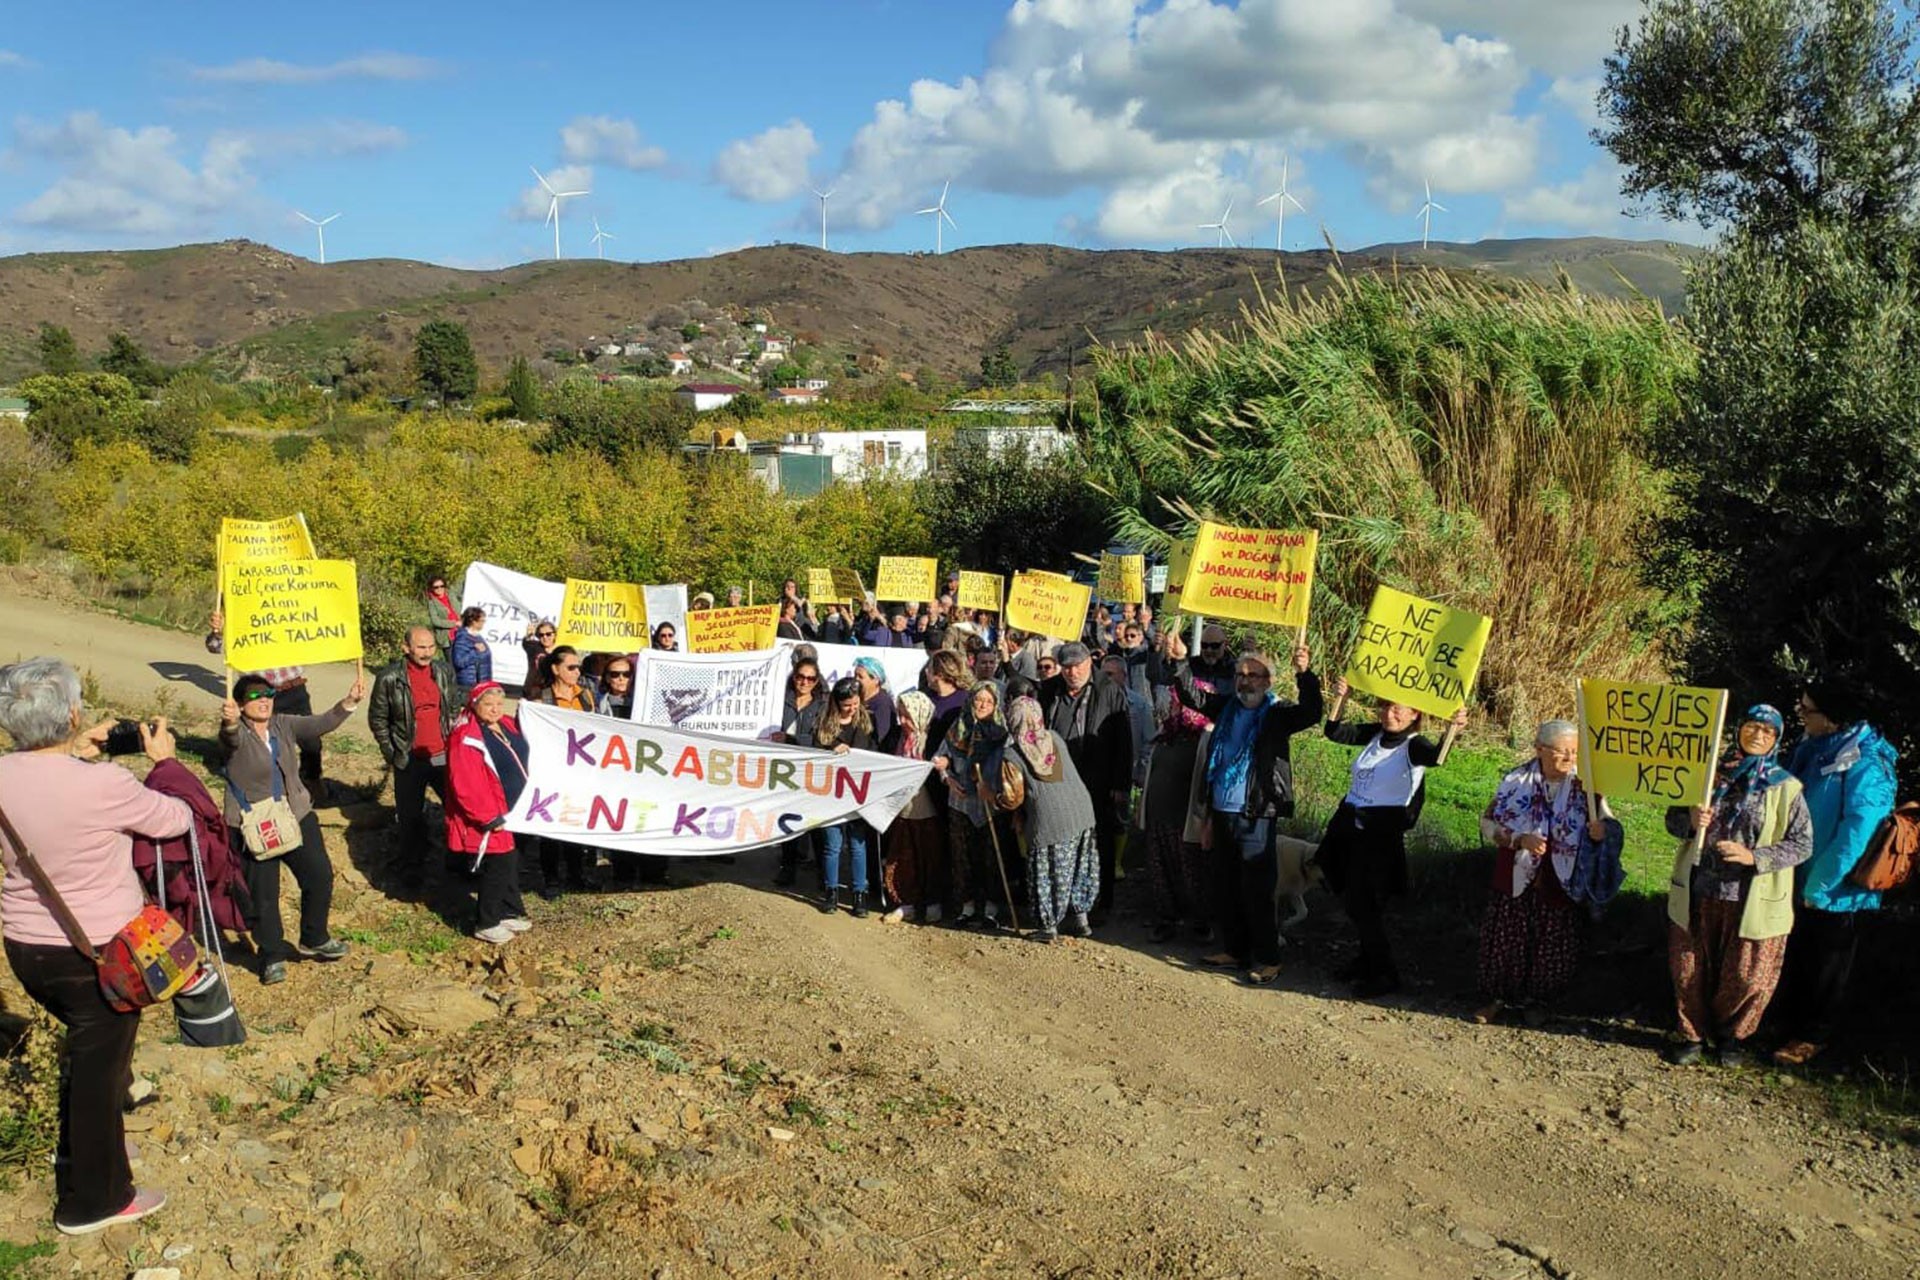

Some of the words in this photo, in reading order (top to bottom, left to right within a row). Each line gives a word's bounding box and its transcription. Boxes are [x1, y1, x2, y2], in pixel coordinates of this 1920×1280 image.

[227, 534, 266, 544] TALANA
[1238, 548, 1281, 564] DOĞAYA
[239, 563, 312, 577] KARABURUN
[231, 579, 252, 596] Özel
[1031, 588, 1070, 603] AZALAN
[250, 607, 318, 628] BIRAKIN
[1402, 603, 1442, 633] NE
[232, 632, 277, 649] ARTIK
[285, 623, 346, 642] TALANI
[566, 619, 648, 639] SAVUNUYORUZ
[696, 634, 709, 642] BU
[1434, 643, 1464, 669] BE
[1589, 726, 1653, 757] YETER
[567, 728, 871, 804] KARABURUN
[1635, 763, 1690, 799] KES
[526, 787, 658, 833] KENT
